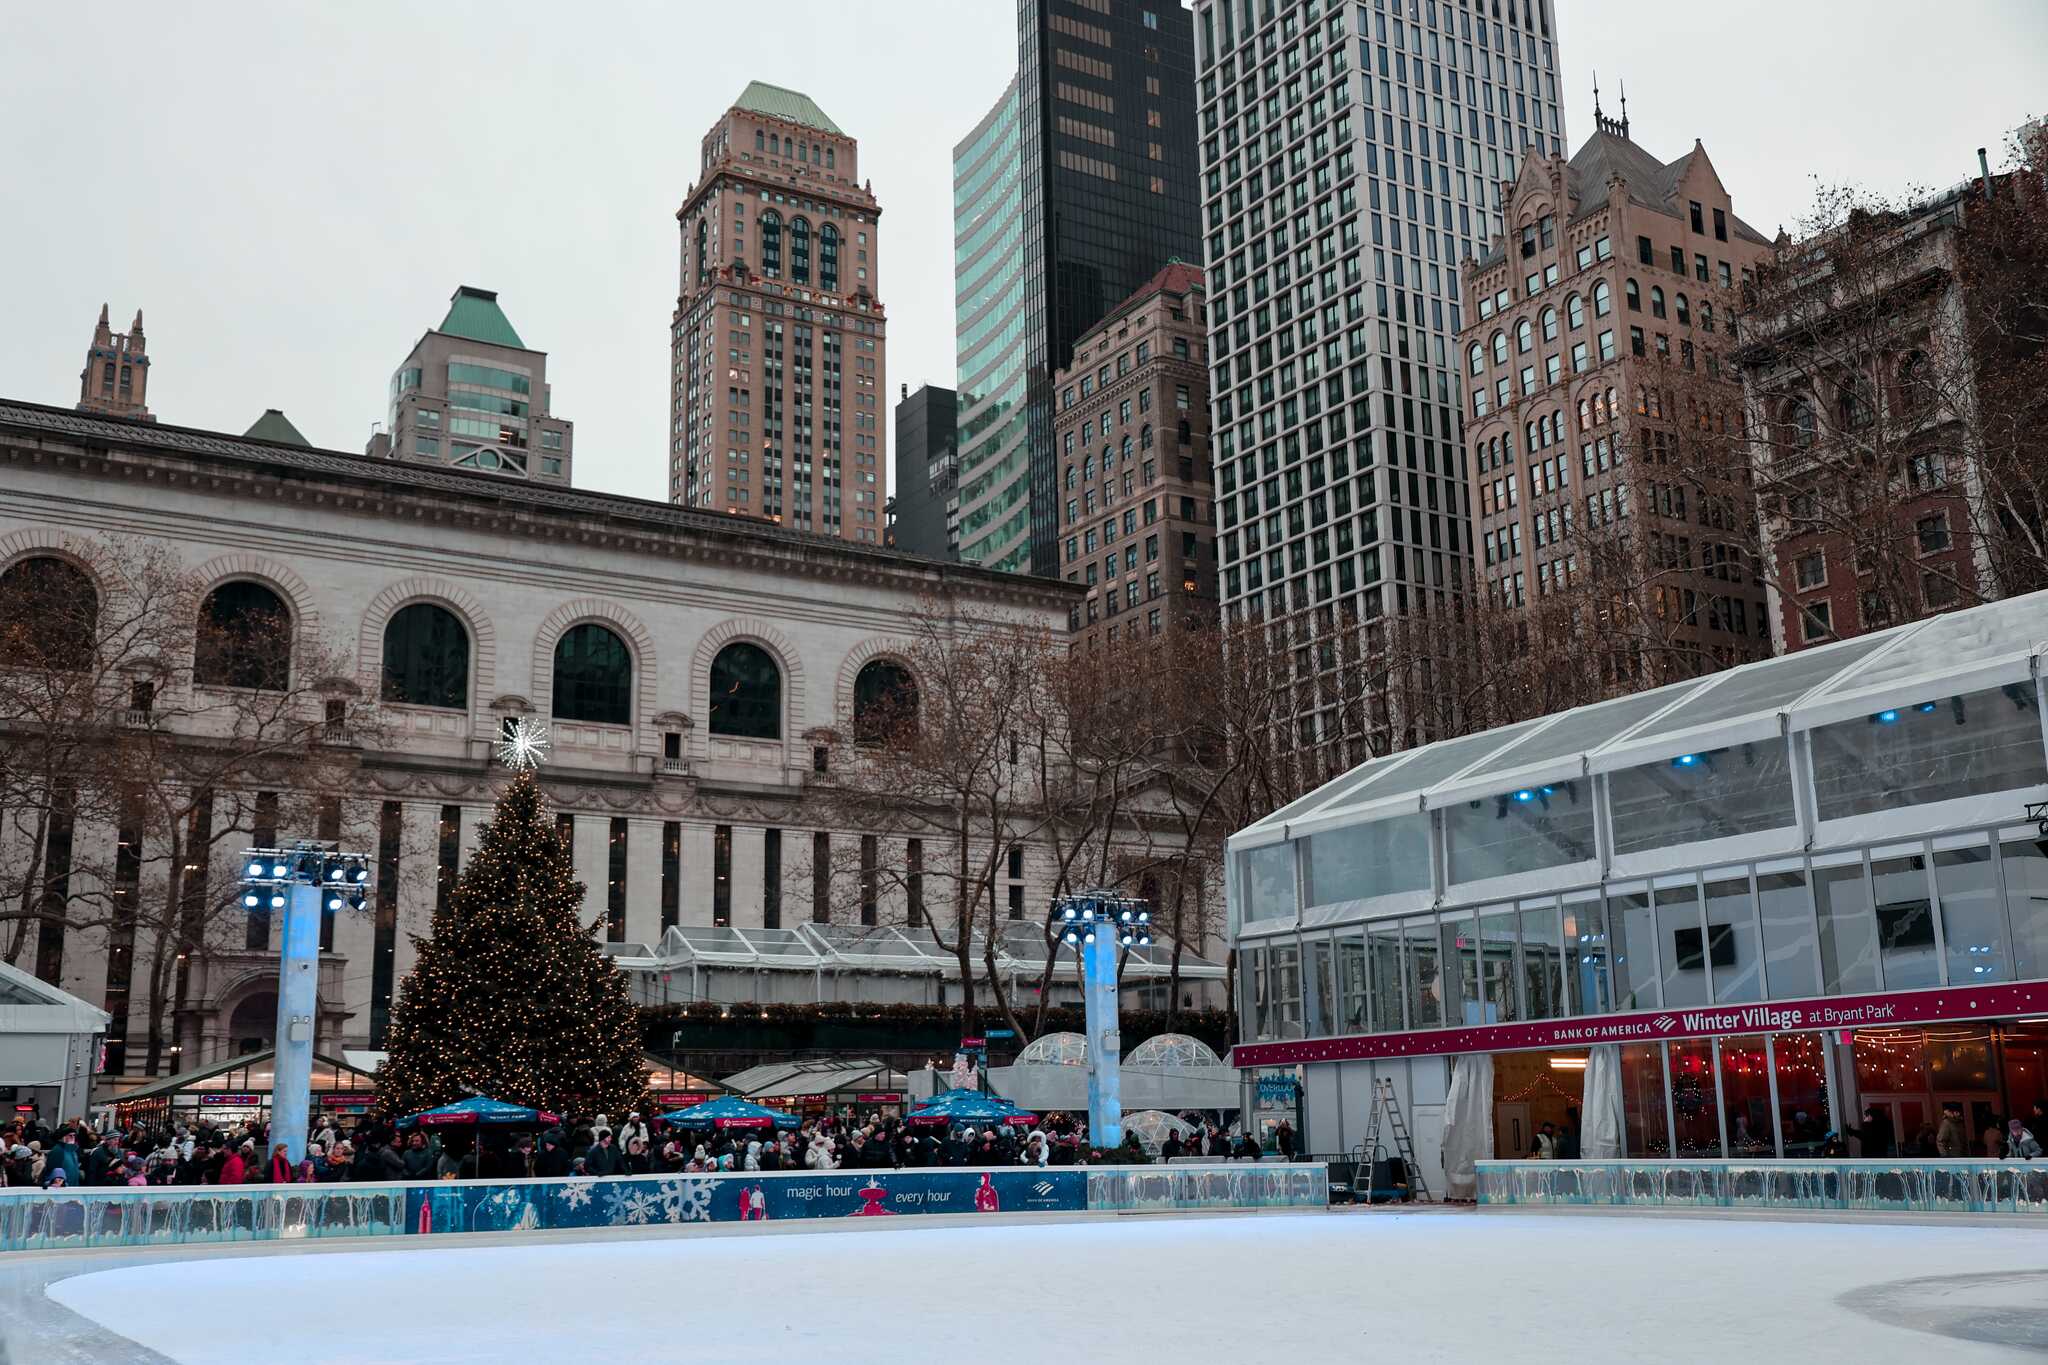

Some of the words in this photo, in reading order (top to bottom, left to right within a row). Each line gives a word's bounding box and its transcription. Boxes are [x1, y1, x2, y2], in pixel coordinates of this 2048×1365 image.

[1554, 1028, 1583, 1040] BANK
[1585, 1028, 1599, 1037] OF
[1601, 1023, 1651, 1036] AMERICA
[1682, 1012, 1740, 1031] Winter
[1743, 1007, 1802, 1029] Village
[1809, 1010, 1822, 1022] at
[1825, 1008, 1864, 1024] Bryant
[1867, 1005, 1893, 1018] Park
[787, 1186, 822, 1201] magic
[826, 1184, 852, 1197] hour
[895, 1191, 924, 1205] every
[927, 1188, 952, 1202] hour
